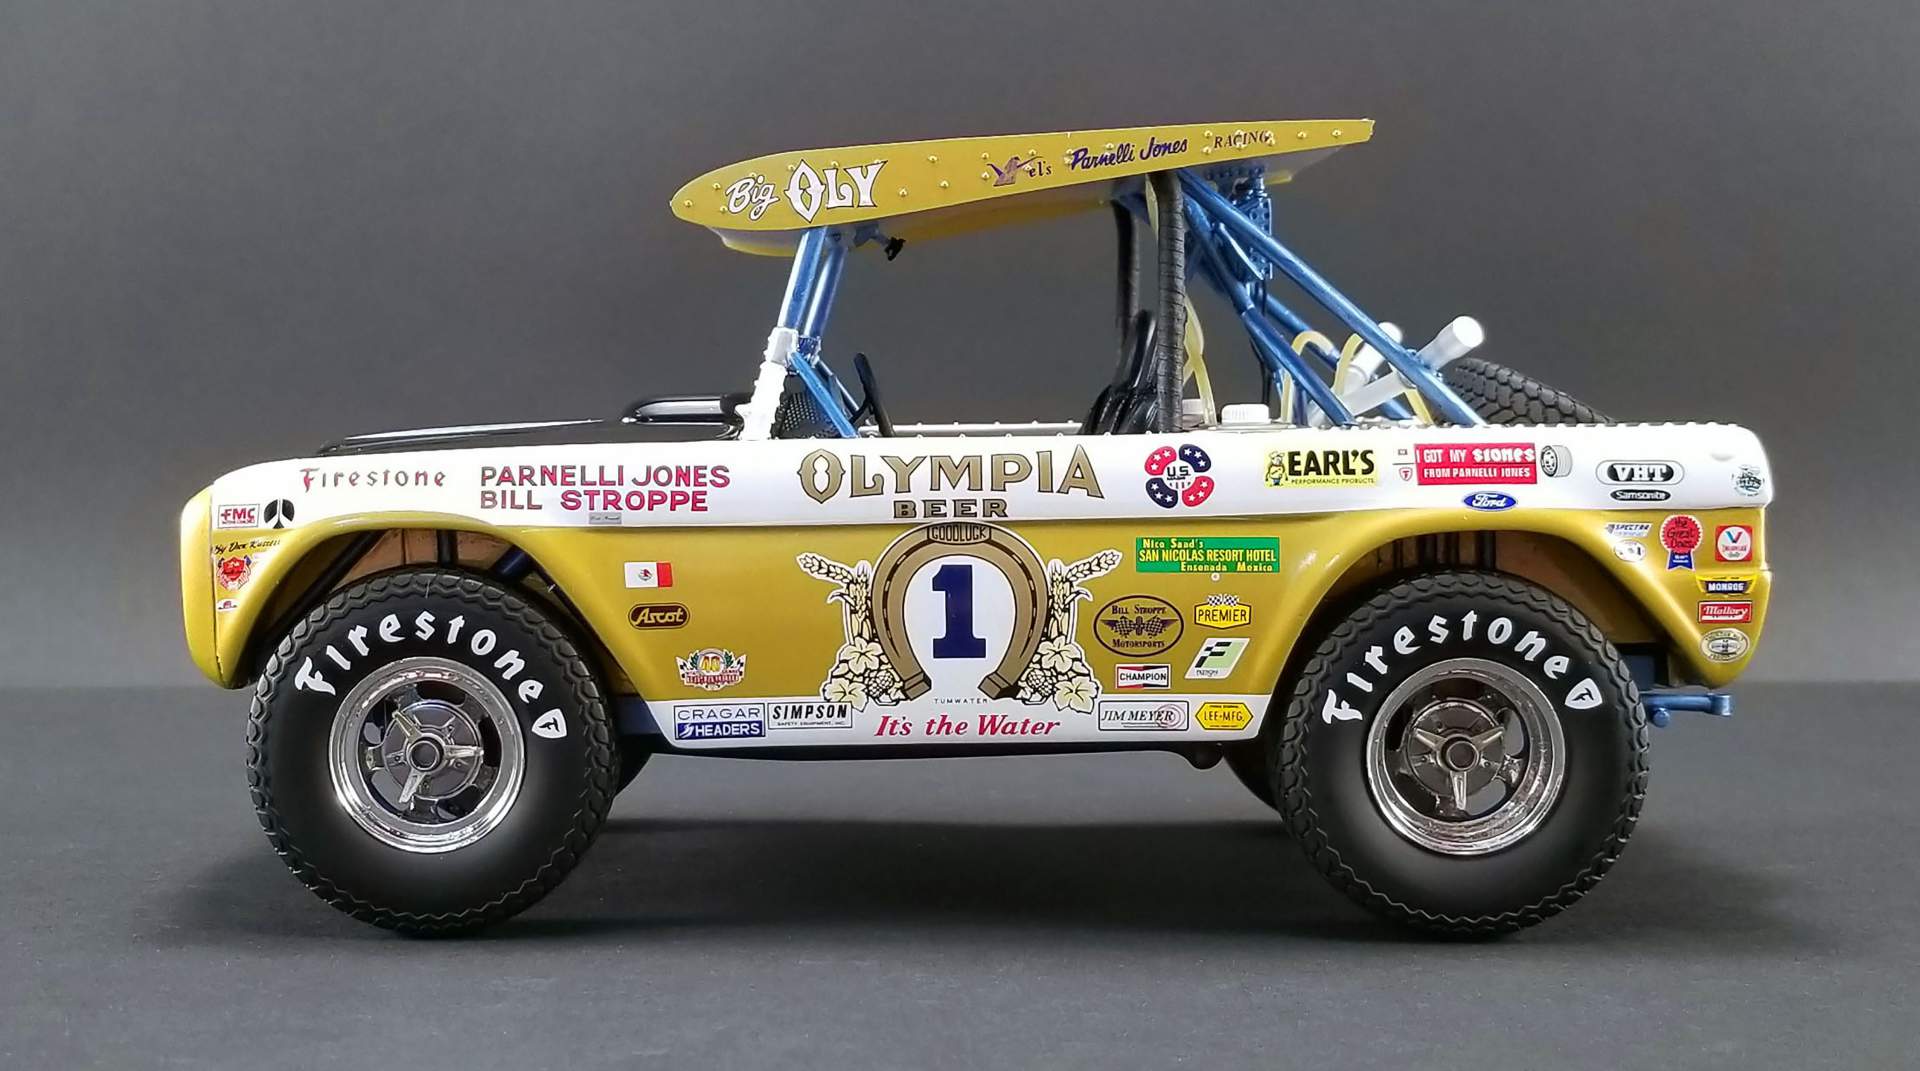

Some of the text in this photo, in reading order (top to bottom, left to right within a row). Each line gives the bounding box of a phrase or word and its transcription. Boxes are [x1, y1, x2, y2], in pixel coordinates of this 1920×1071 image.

[1071, 143, 1136, 171] Parnelli
[1139, 136, 1188, 161] Jones
[725, 159, 888, 223] Big OLY
[1288, 449, 1375, 476] EARL'S
[1423, 448, 1444, 463] GOT
[1449, 448, 1467, 463] MY
[300, 467, 447, 493] Firestone
[480, 465, 731, 488] PARNELLI JONES
[796, 444, 1105, 504] OLYMPIA
[1423, 467, 1531, 478] FROM PARNELLI JONES
[1612, 464, 1668, 482] VHT
[1291, 477, 1340, 485] PERFORMANCE
[480, 489, 709, 512] BILL STROPPE
[1471, 493, 1507, 507] Ford
[1615, 490, 1667, 500] Samsonite
[220, 507, 256, 520] FMC
[893, 498, 1009, 518] BEER
[1142, 538, 1165, 549] Nico
[1139, 549, 1277, 562] SAN NICOLAS RESORT HOTEL
[1180, 561, 1273, 572] Ensenada Mexico
[632, 607, 684, 625] Ascot
[931, 564, 987, 659] 1
[1197, 609, 1247, 622] PREMIER
[1703, 605, 1749, 617] Mallory
[294, 610, 544, 704] Firestone
[1321, 610, 1570, 725] Firestone
[1119, 672, 1167, 681] CHAMPION
[677, 707, 761, 721] CRAGAR
[772, 704, 848, 719] SIMPSON
[1101, 710, 1175, 721] JIM MEYER
[695, 722, 761, 737] HEADERS
[874, 714, 1061, 737] It's the Water
